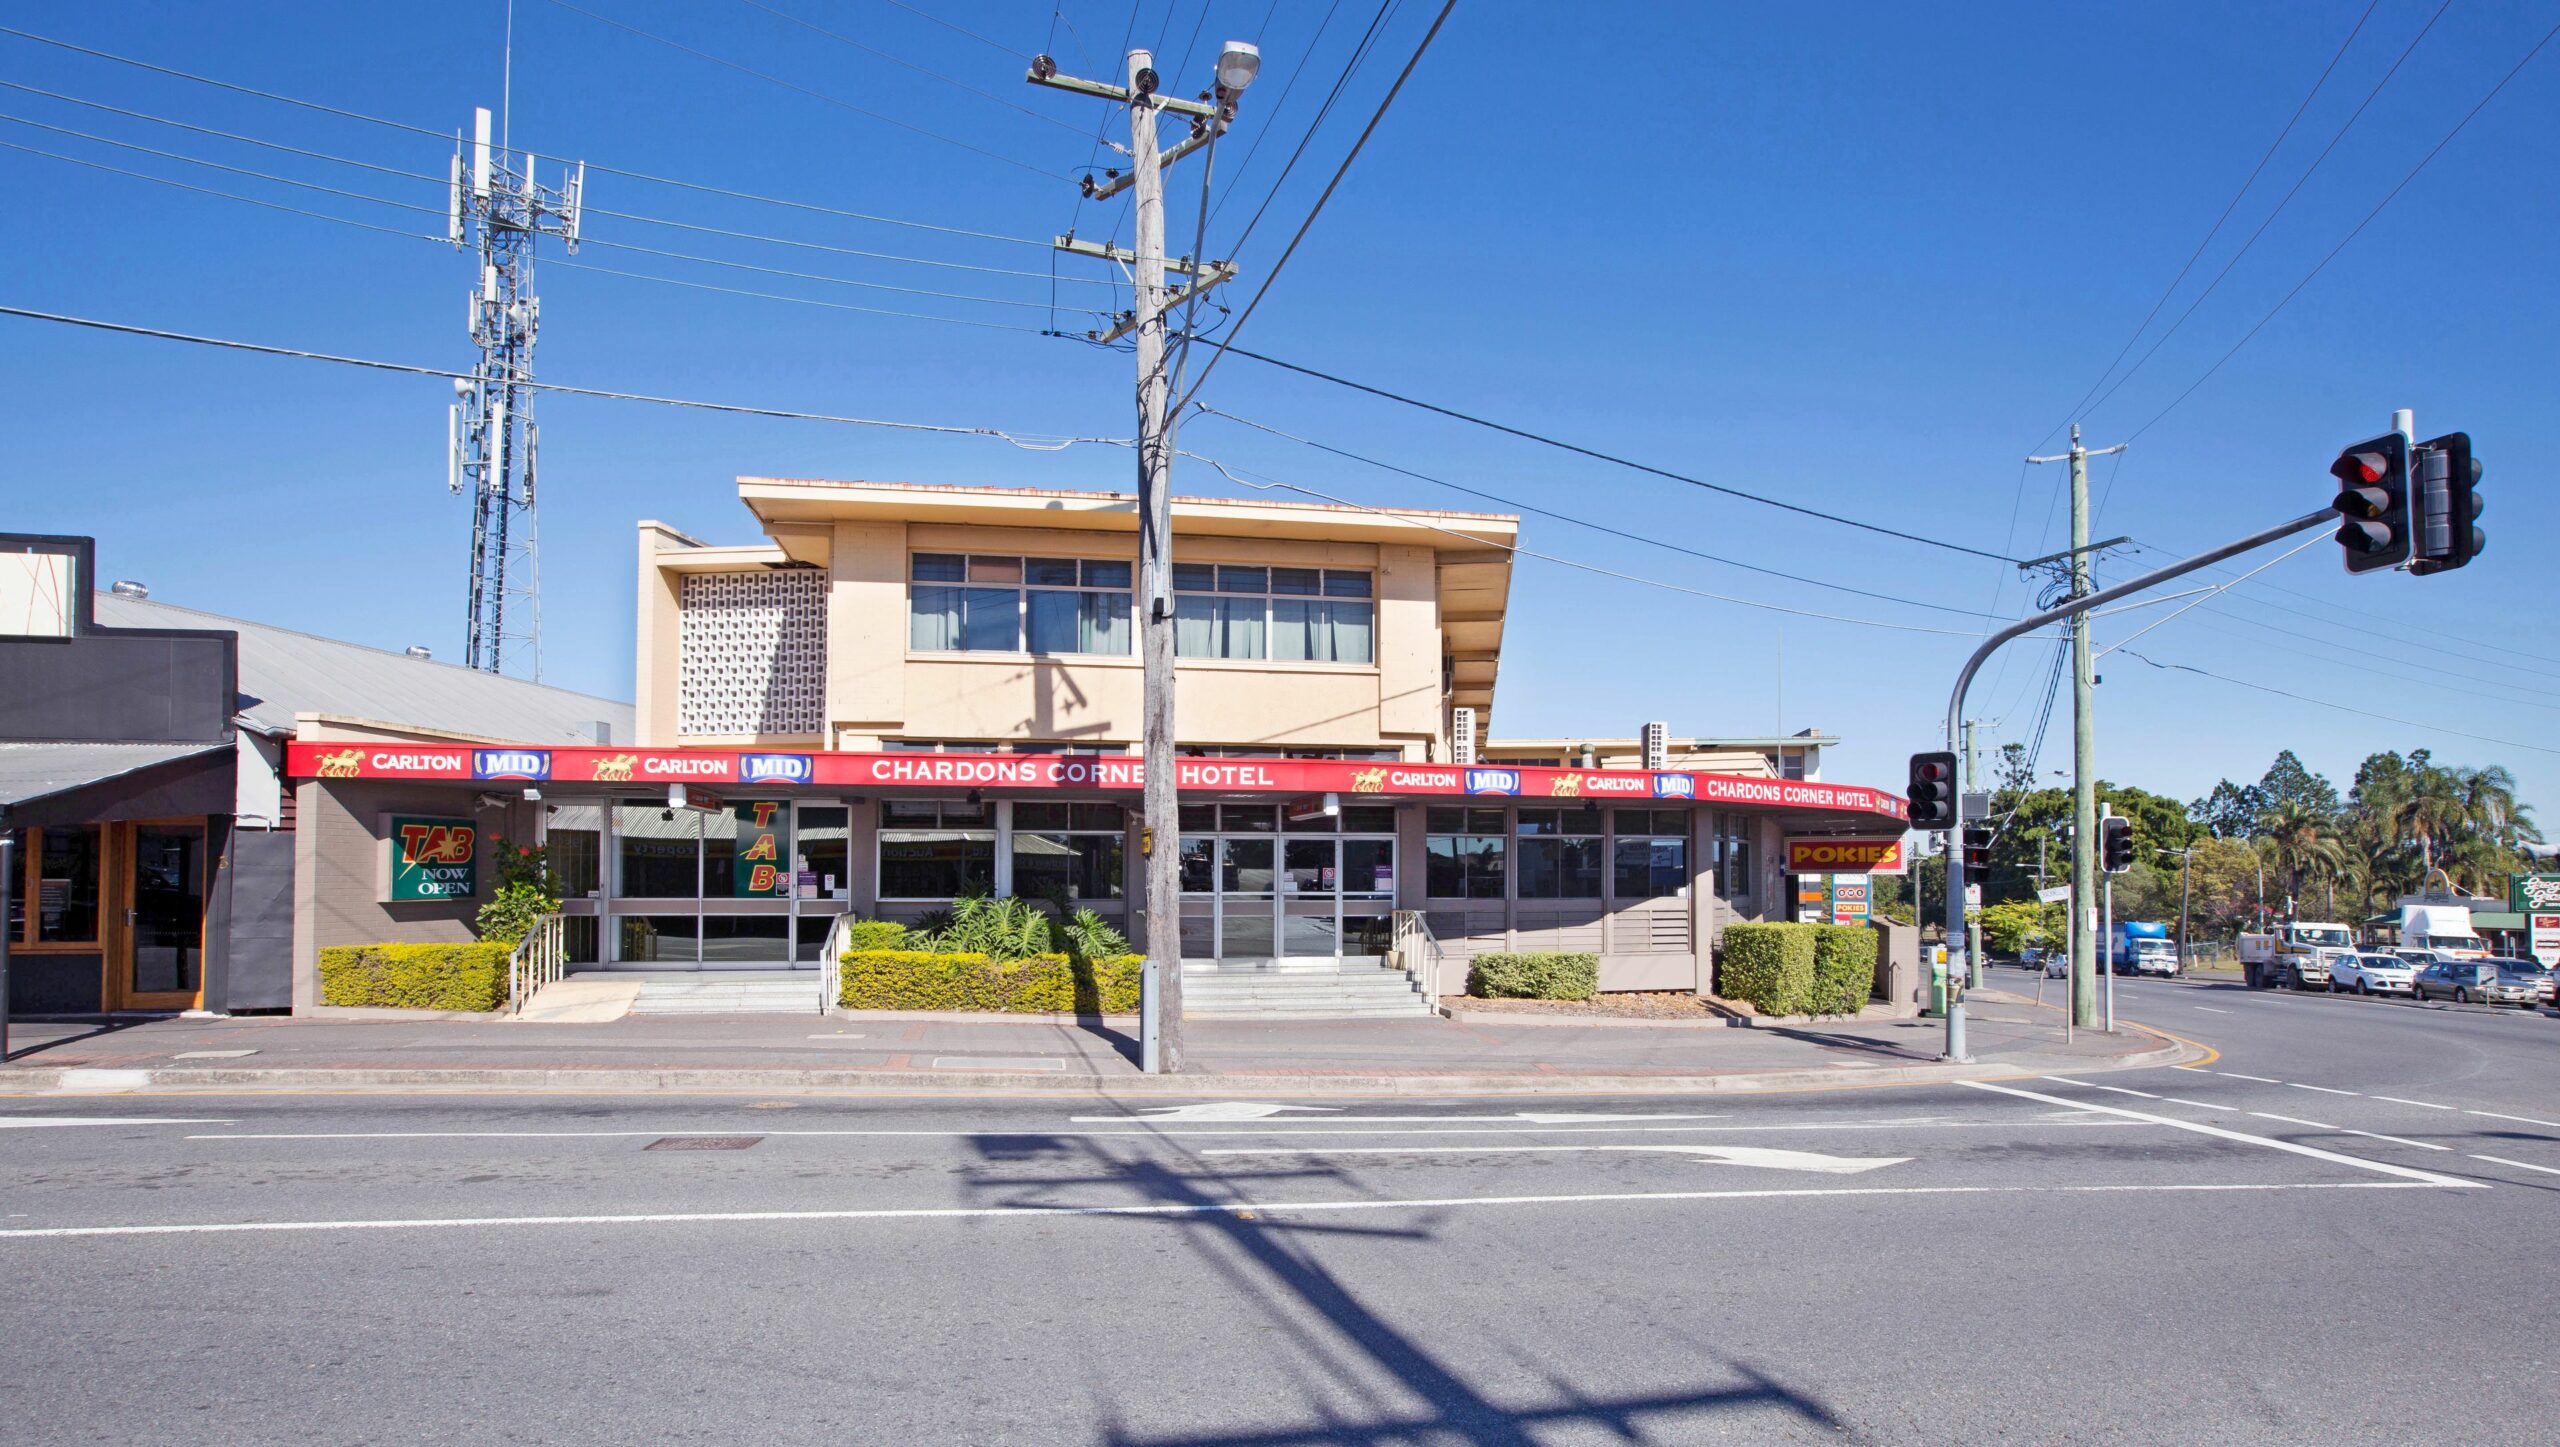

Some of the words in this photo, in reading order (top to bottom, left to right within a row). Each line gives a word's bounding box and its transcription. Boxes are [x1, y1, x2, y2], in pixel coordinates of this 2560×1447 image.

[372, 753, 462, 770] CARLTON
[485, 754, 540, 774] MID
[644, 757, 728, 775] CARLTON
[751, 758, 802, 779] MID
[872, 760, 1037, 782] CHARDONS
[1047, 763, 1144, 783] CORNE
[1181, 765, 1274, 786] HOTEL
[1391, 771, 1456, 787] CARLTON
[1473, 772, 1513, 790] MID
[1586, 776, 1645, 791] CARLTON
[1660, 777, 1690, 794] MID
[1708, 780, 1781, 801] CHARDONS
[1784, 786, 1834, 805] CORNER
[1836, 791, 1873, 808] HOTEL
[400, 824, 475, 865] TAB
[743, 802, 778, 891] TAB
[1793, 845, 1898, 863] POKIES
[421, 867, 469, 881] NOW
[417, 882, 470, 895] OPEN
[1837, 904, 1864, 912] POKIES
